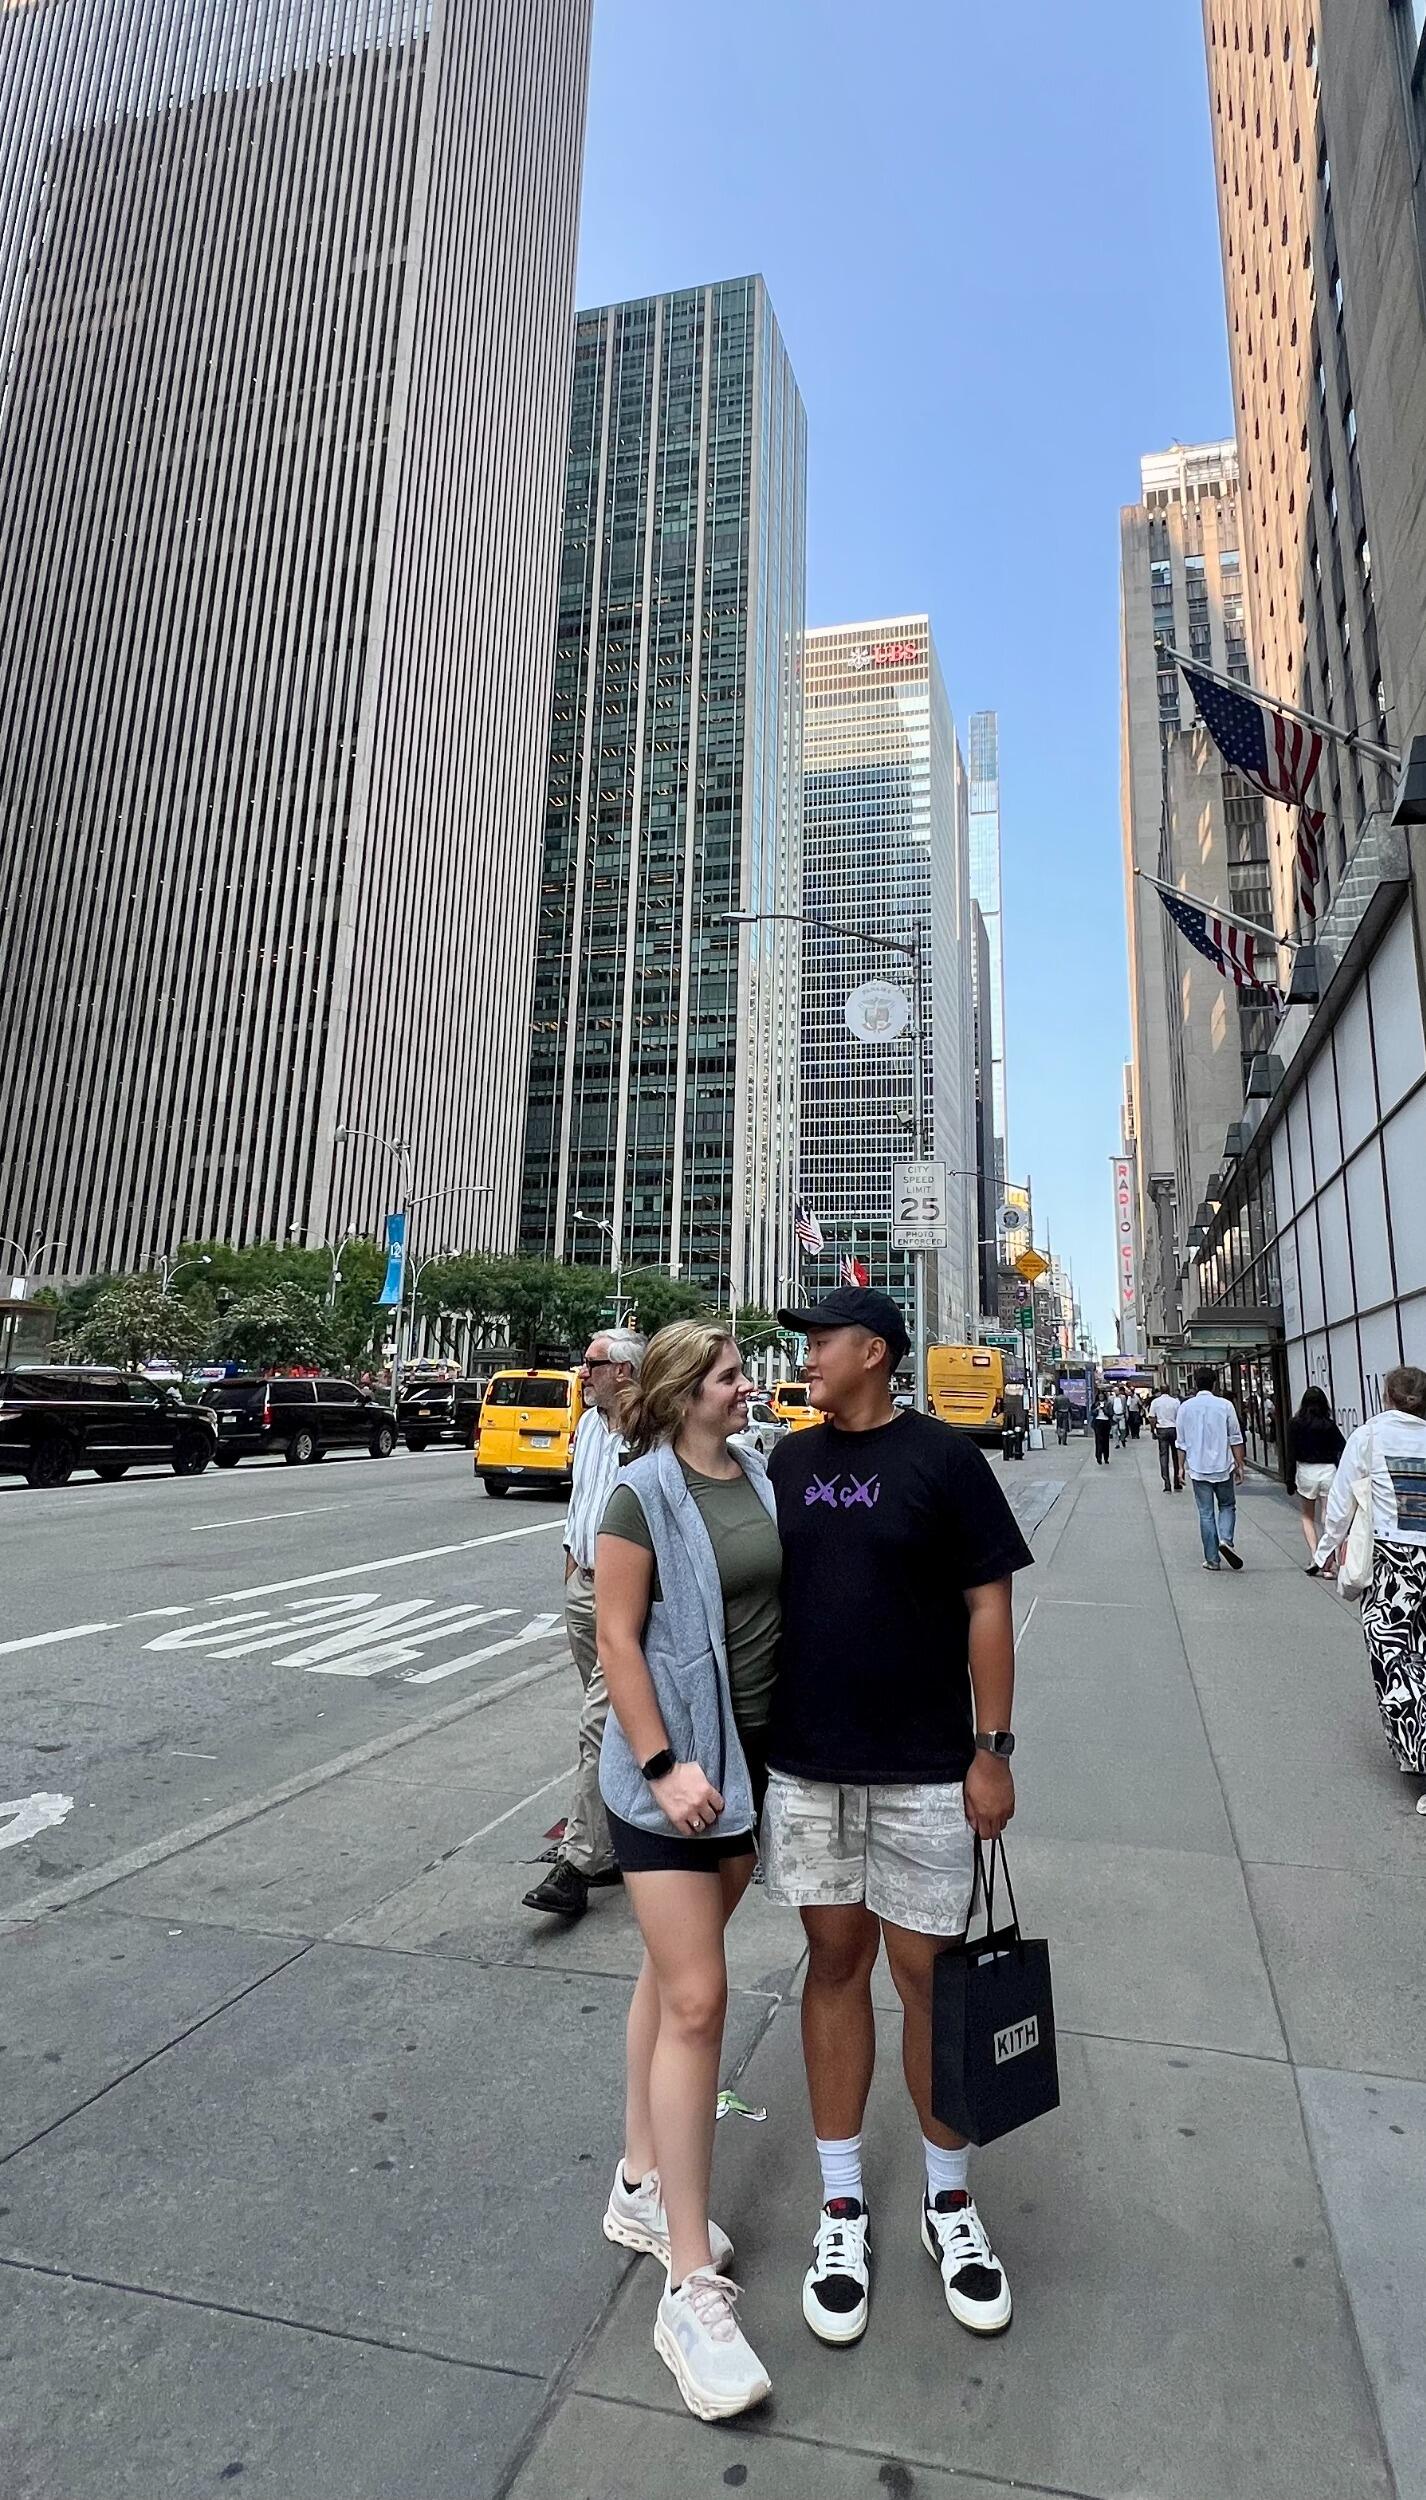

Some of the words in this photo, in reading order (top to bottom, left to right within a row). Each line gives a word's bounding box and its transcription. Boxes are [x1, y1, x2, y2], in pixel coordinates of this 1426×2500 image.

[874, 643, 917, 663] UBS
[903, 1176, 935, 1184] SPEED
[907, 1166, 930, 1174] CITY
[906, 1186, 932, 1194] LIMIT
[1116, 1165, 1131, 1232] RADIO
[900, 1197, 941, 1221] 25
[898, 1238, 943, 1246] ENFORCED
[1122, 1246, 1135, 1301] CITY
[998, 2021, 1036, 2057] KITH
